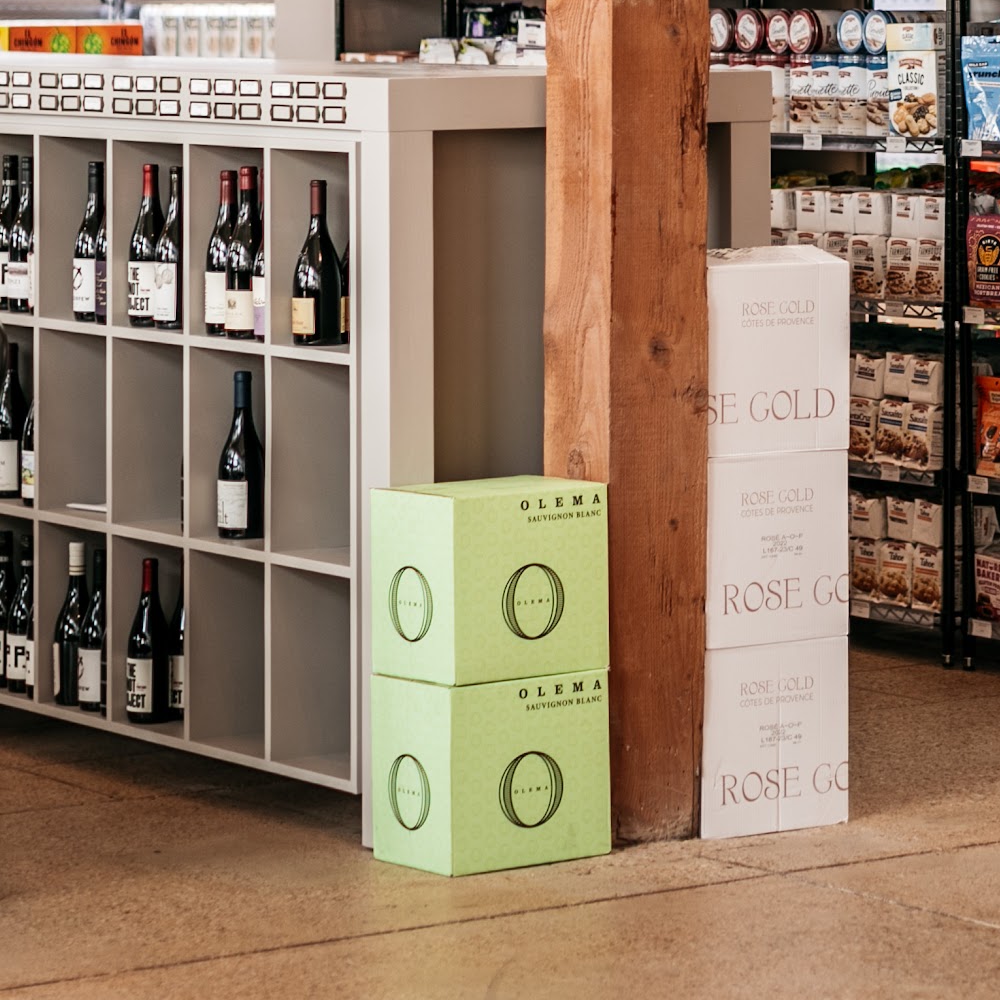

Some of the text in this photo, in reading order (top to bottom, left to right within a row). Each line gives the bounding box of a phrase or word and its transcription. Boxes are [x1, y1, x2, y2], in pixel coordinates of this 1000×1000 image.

[897, 71, 925, 86] CLASSIC
[742, 300, 815, 316] ROSE GOLD
[766, 318, 775, 327] DE
[777, 317, 815, 326] PROVENCE
[708, 388, 835, 426] SE GOLD
[741, 487, 814, 506] ROSE GOLD
[527, 509, 602, 523] SAUVIGNON BLANC
[765, 507, 775, 516] DE
[777, 505, 814, 515] PROVENCE
[723, 573, 849, 615] ROSE GO
[740, 676, 814, 696] ROSE GOLD
[526, 695, 602, 711] SAUVIGNON BLANC
[764, 697, 774, 706] DE
[776, 693, 814, 704] PROVENCE
[721, 761, 849, 806] ROSE GO
